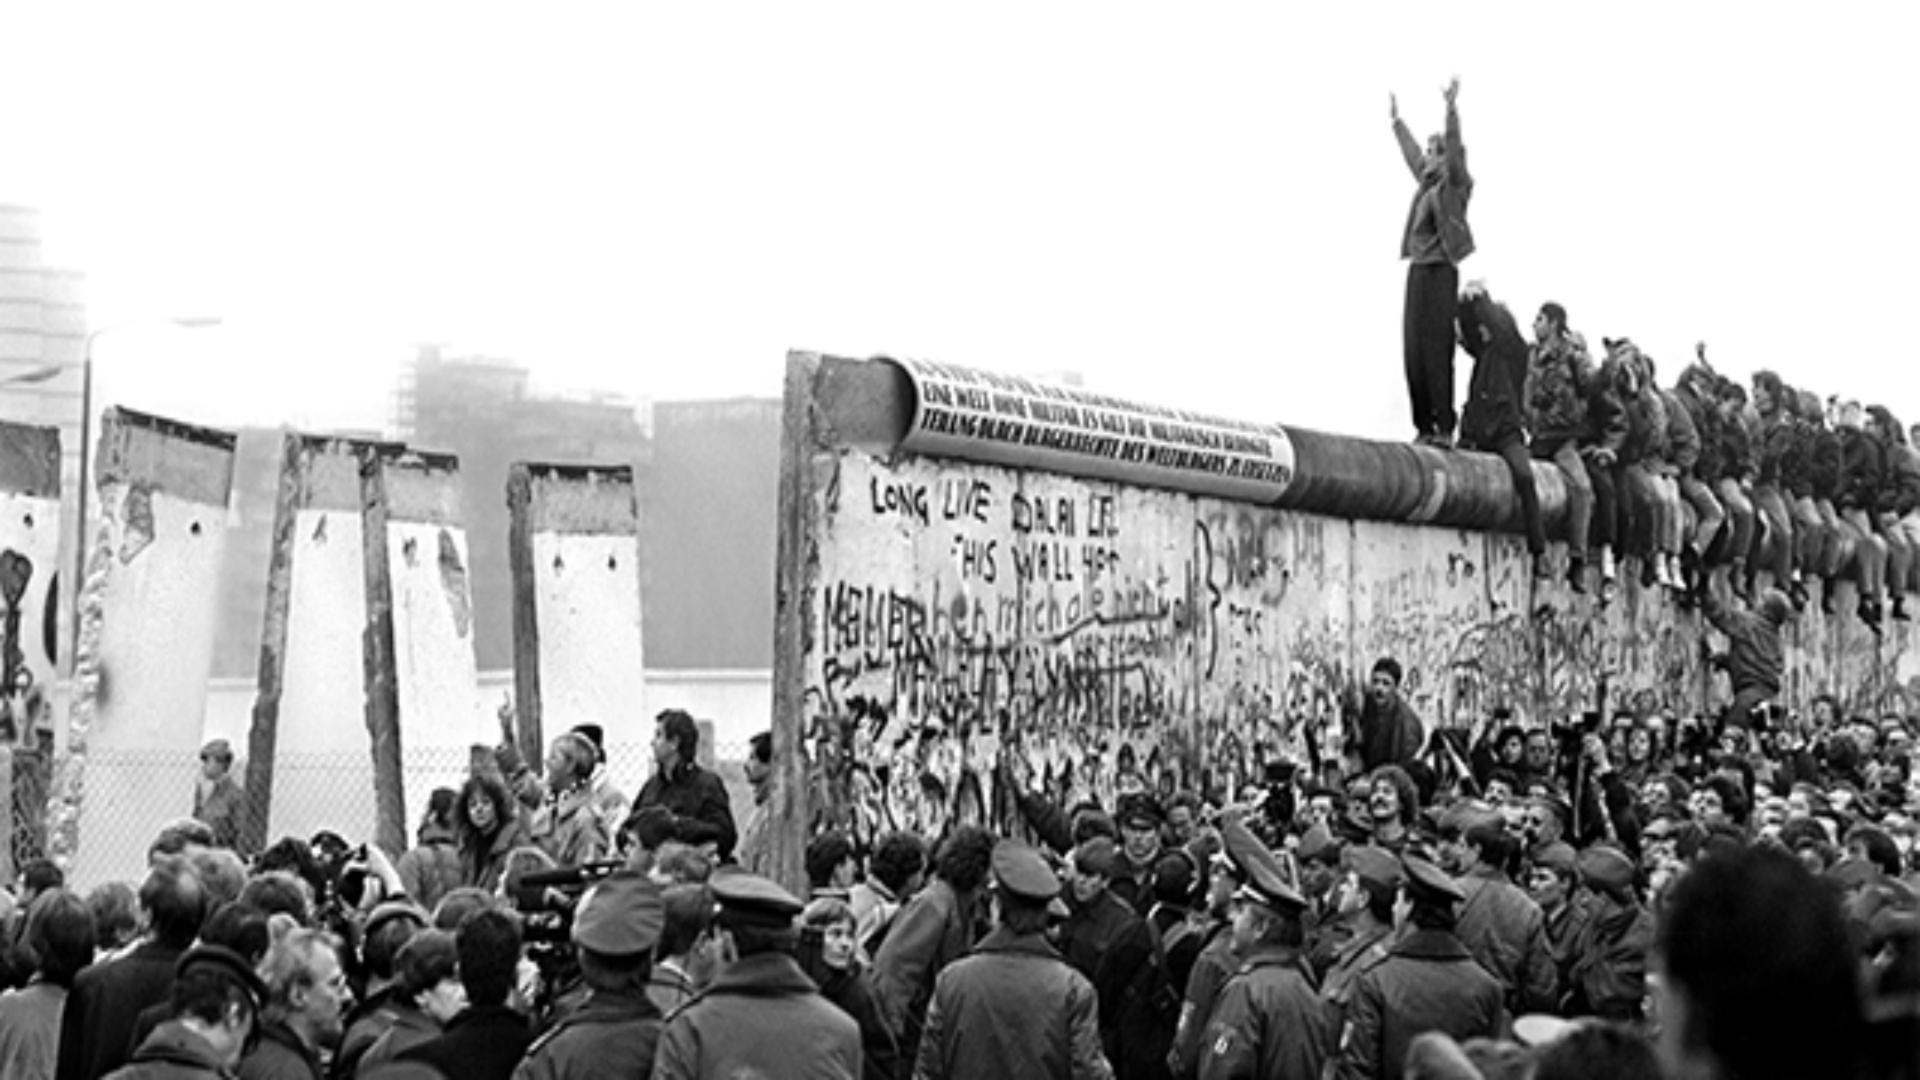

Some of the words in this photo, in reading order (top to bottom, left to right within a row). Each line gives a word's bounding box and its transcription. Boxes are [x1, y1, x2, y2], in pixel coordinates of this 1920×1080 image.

[871, 475, 930, 527] LONG
[943, 479, 991, 524] LIVE
[1011, 492, 1076, 538] DALAI
[1011, 542, 1073, 583] WALL
